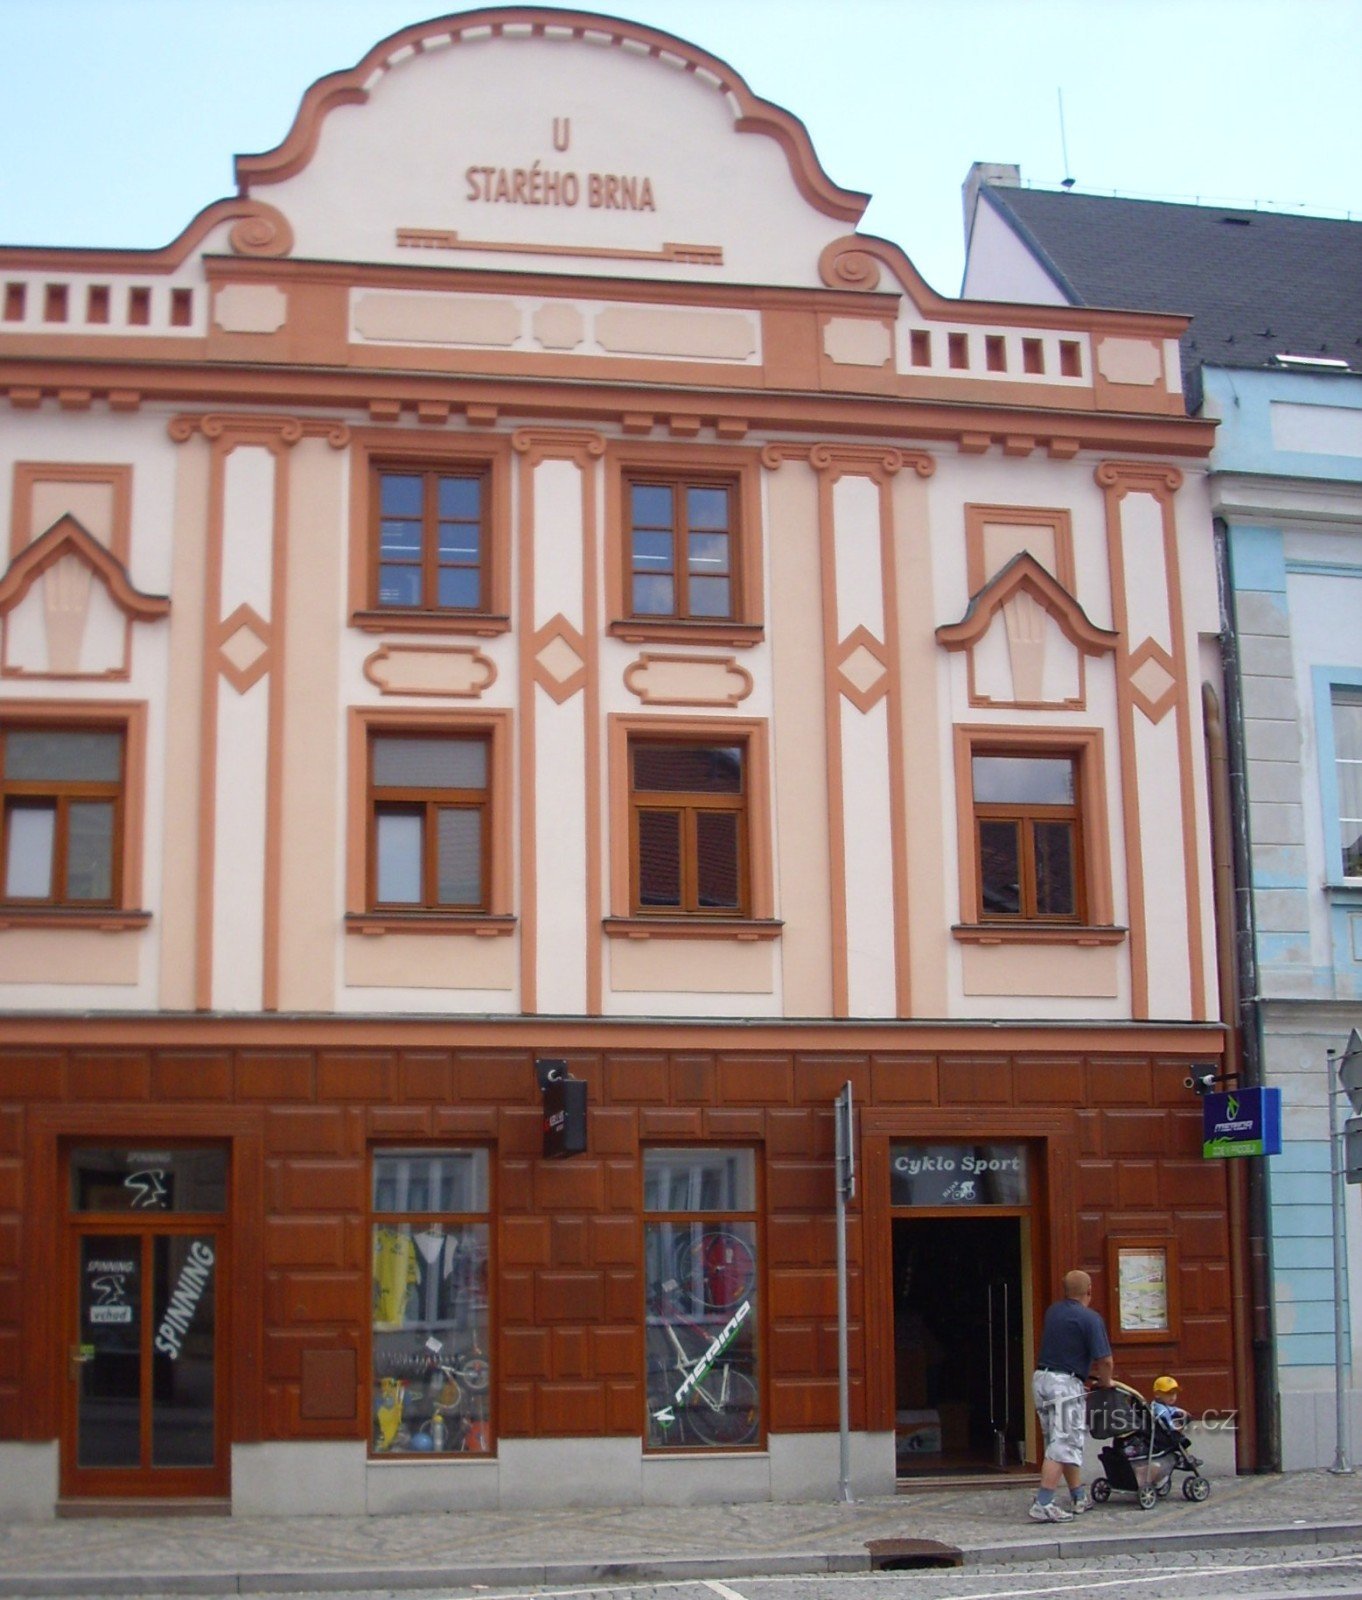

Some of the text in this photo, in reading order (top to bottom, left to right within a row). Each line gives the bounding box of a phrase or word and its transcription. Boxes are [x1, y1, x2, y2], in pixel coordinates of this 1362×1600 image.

[553, 117, 571, 152] U
[465, 160, 657, 212] STARÉHO BRNA
[894, 1155, 1021, 1175] Cyklo Sport
[87, 1260, 134, 1272] SPINNING
[94, 1307, 128, 1320] vchod
[155, 1241, 215, 1360] SPINNING
